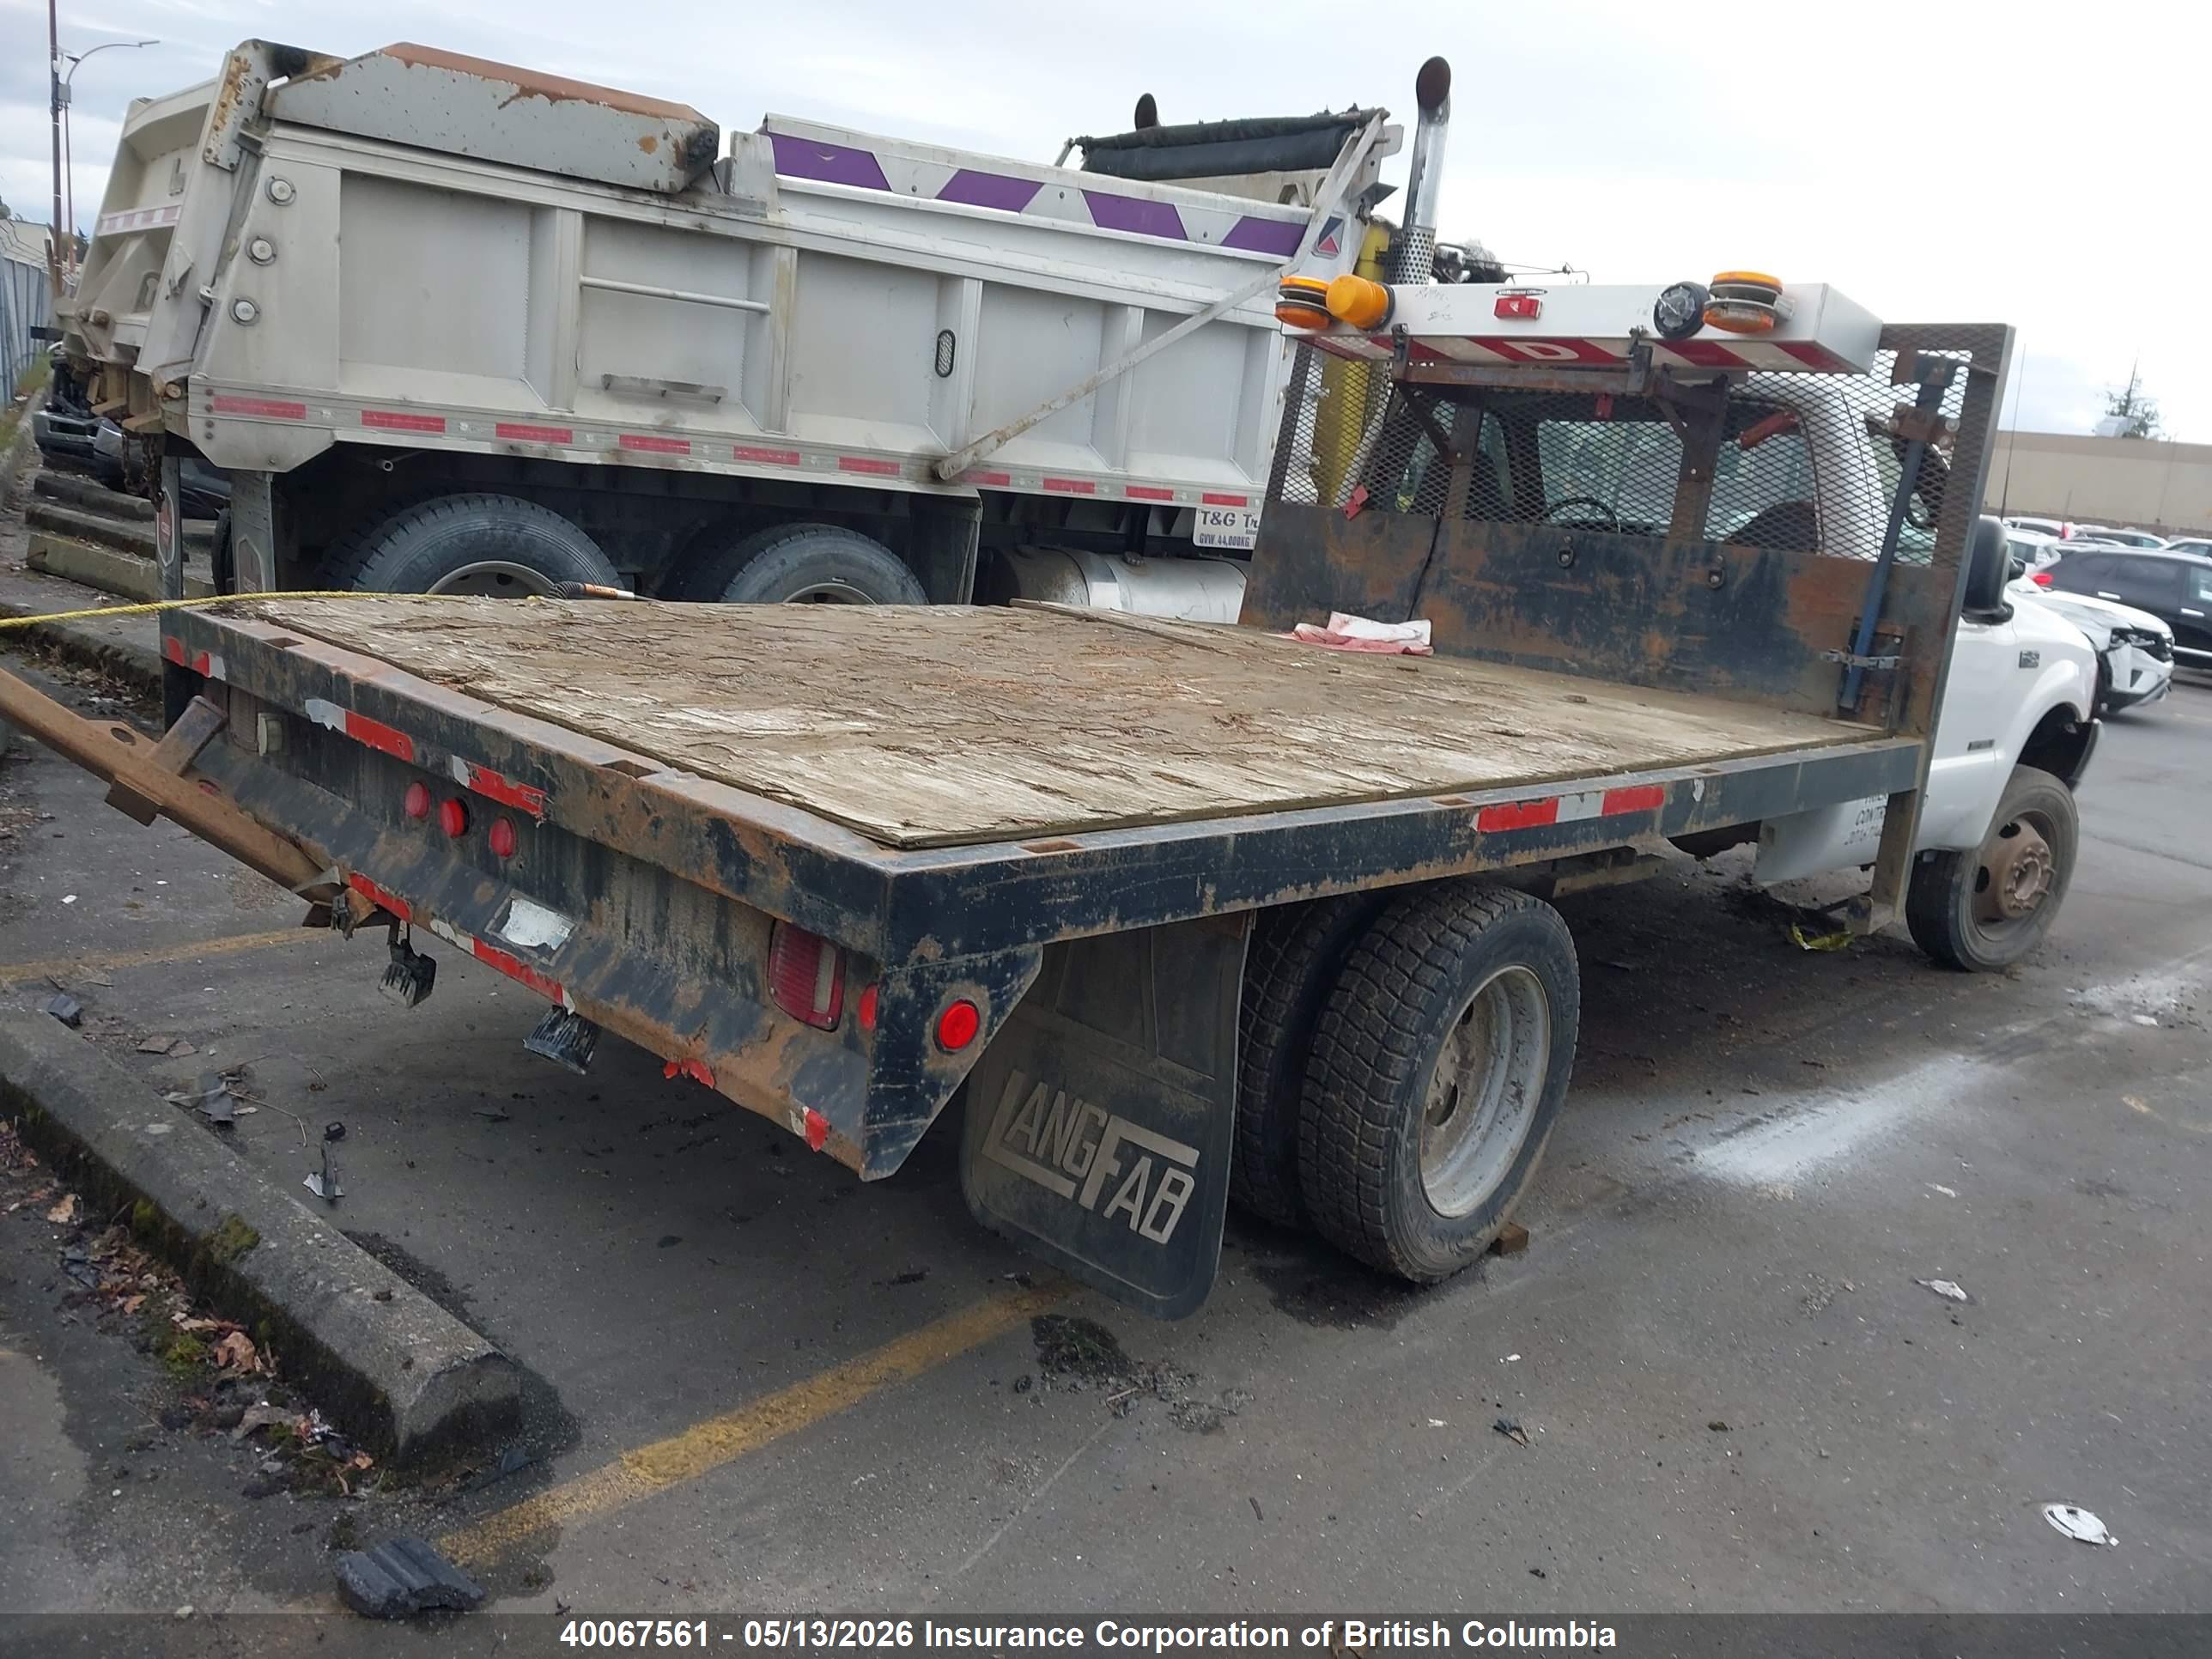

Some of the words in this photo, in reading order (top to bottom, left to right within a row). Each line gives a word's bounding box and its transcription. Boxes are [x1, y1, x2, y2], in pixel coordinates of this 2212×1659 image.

[1201, 510, 1236, 526] T&G
[1200, 533, 1215, 544] GVW
[1218, 535, 1250, 547] 44,000KG
[981, 1069, 1200, 1245] LANGFAB
